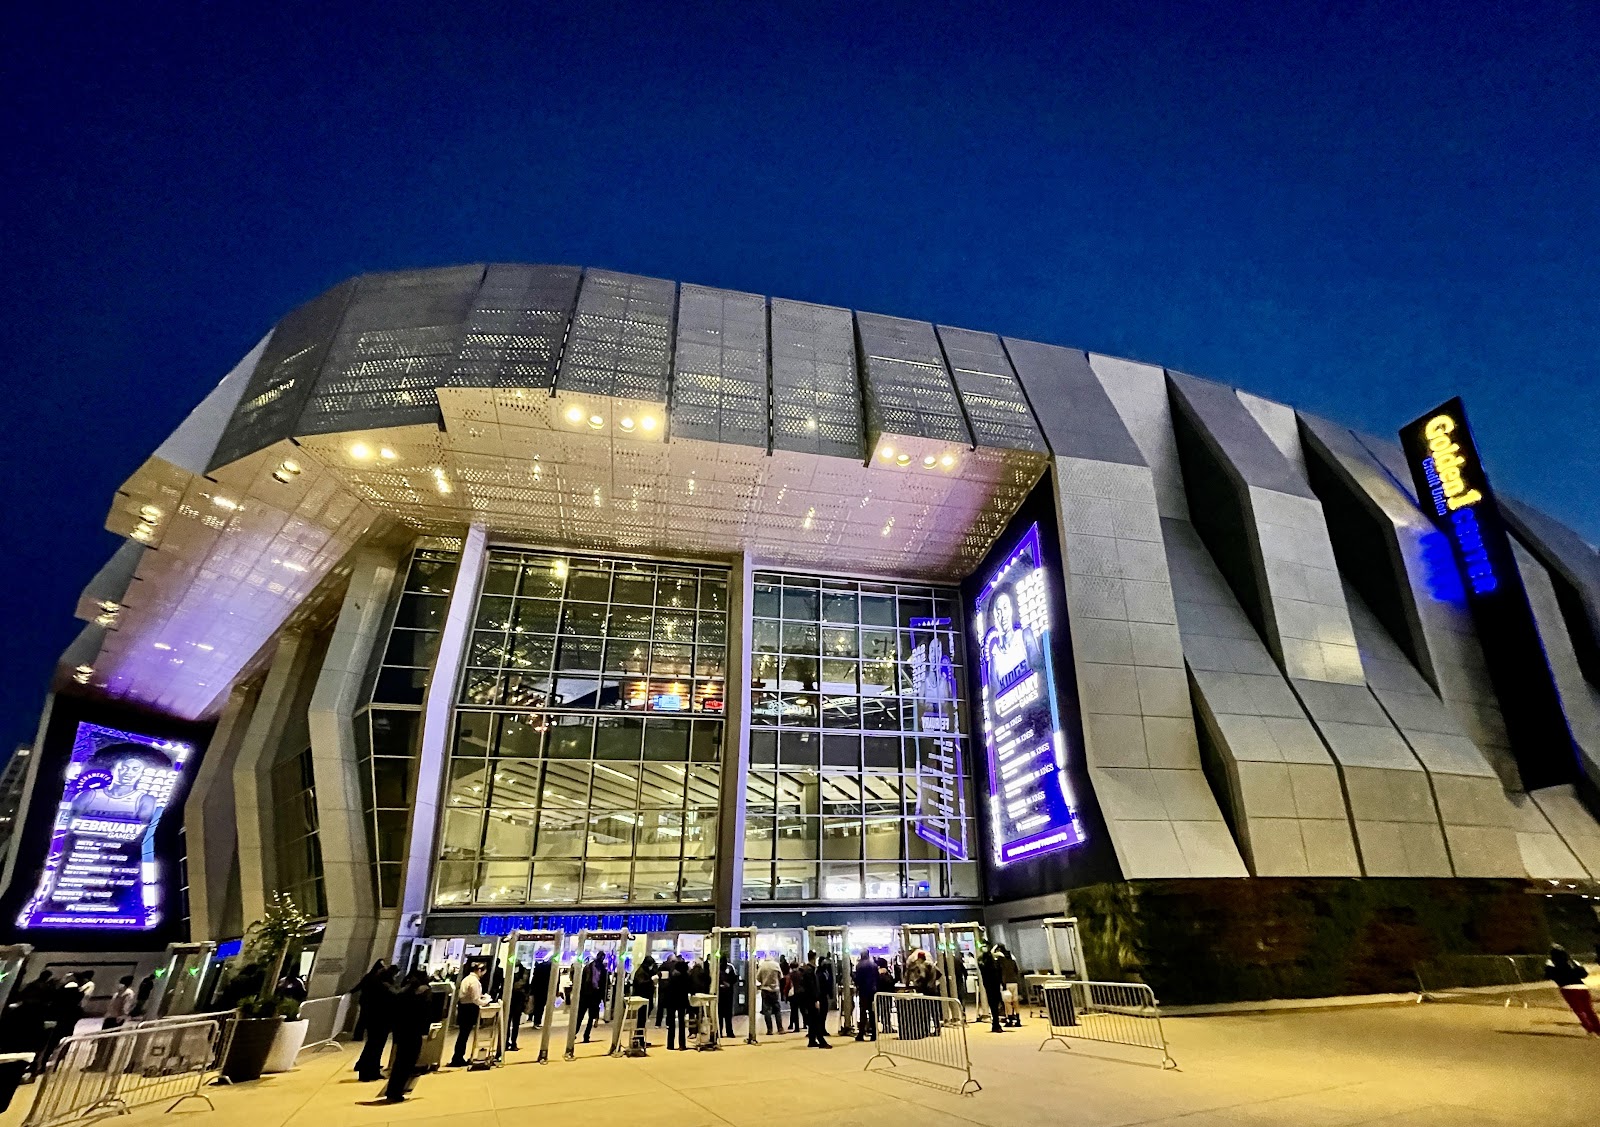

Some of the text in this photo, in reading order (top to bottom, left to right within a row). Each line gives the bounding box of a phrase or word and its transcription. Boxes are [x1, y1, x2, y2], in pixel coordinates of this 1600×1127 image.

[1425, 414, 1466, 498] Golden
[1447, 488, 1482, 510] 1
[1422, 456, 1447, 516] Credit Union
[994, 671, 1039, 716] FEBRUARY
[139, 775, 176, 787] SAC
[143, 767, 179, 779] SAC
[70, 818, 148, 835] FEBRUARY
[107, 832, 137, 841] GAMES
